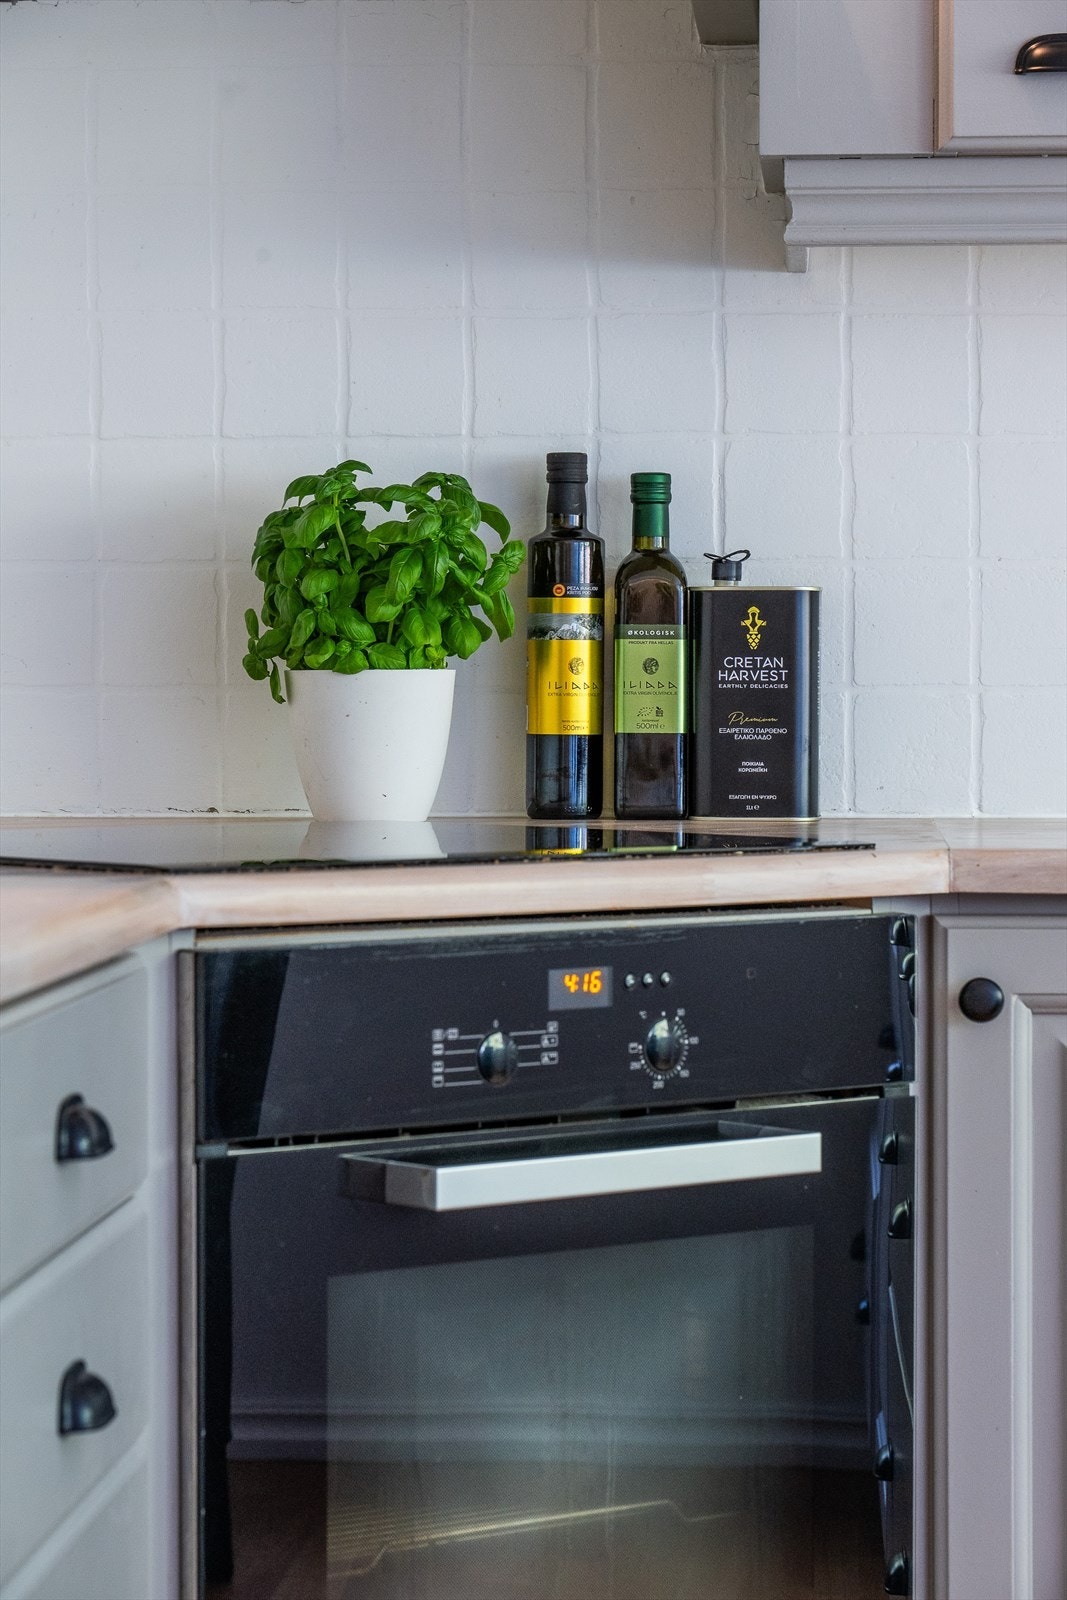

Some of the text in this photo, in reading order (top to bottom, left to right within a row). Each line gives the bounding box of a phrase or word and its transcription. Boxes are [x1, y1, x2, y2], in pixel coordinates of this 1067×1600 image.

[723, 656, 784, 668] CRETAN
[718, 670, 789, 681] HARVEST
[623, 680, 678, 689] ILIADA
[727, 711, 779, 726] Premium
[563, 970, 602, 994] 4:16
